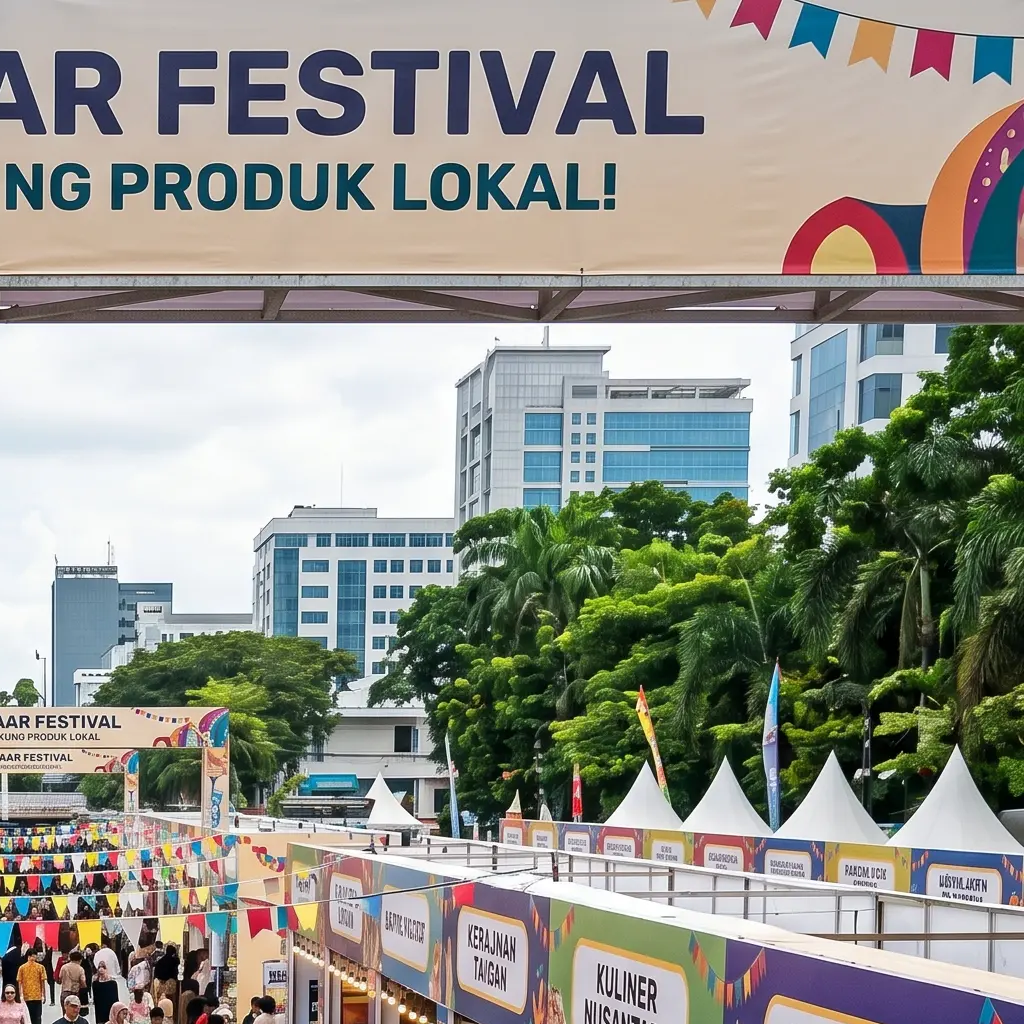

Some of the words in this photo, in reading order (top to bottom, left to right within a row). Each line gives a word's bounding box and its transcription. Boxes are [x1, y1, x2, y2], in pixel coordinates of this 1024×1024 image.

[158, 50, 705, 136] FESTIVAL
[111, 162, 375, 211] PRODUK
[393, 162, 617, 211] LOKAL!
[27, 733, 67, 741] PRODUK
[69, 733, 101, 741] LOKAL
[35, 714, 122, 729] FESTIVAL
[23, 753, 74, 762] FESTIVAL
[596, 963, 658, 1014] KULINER
